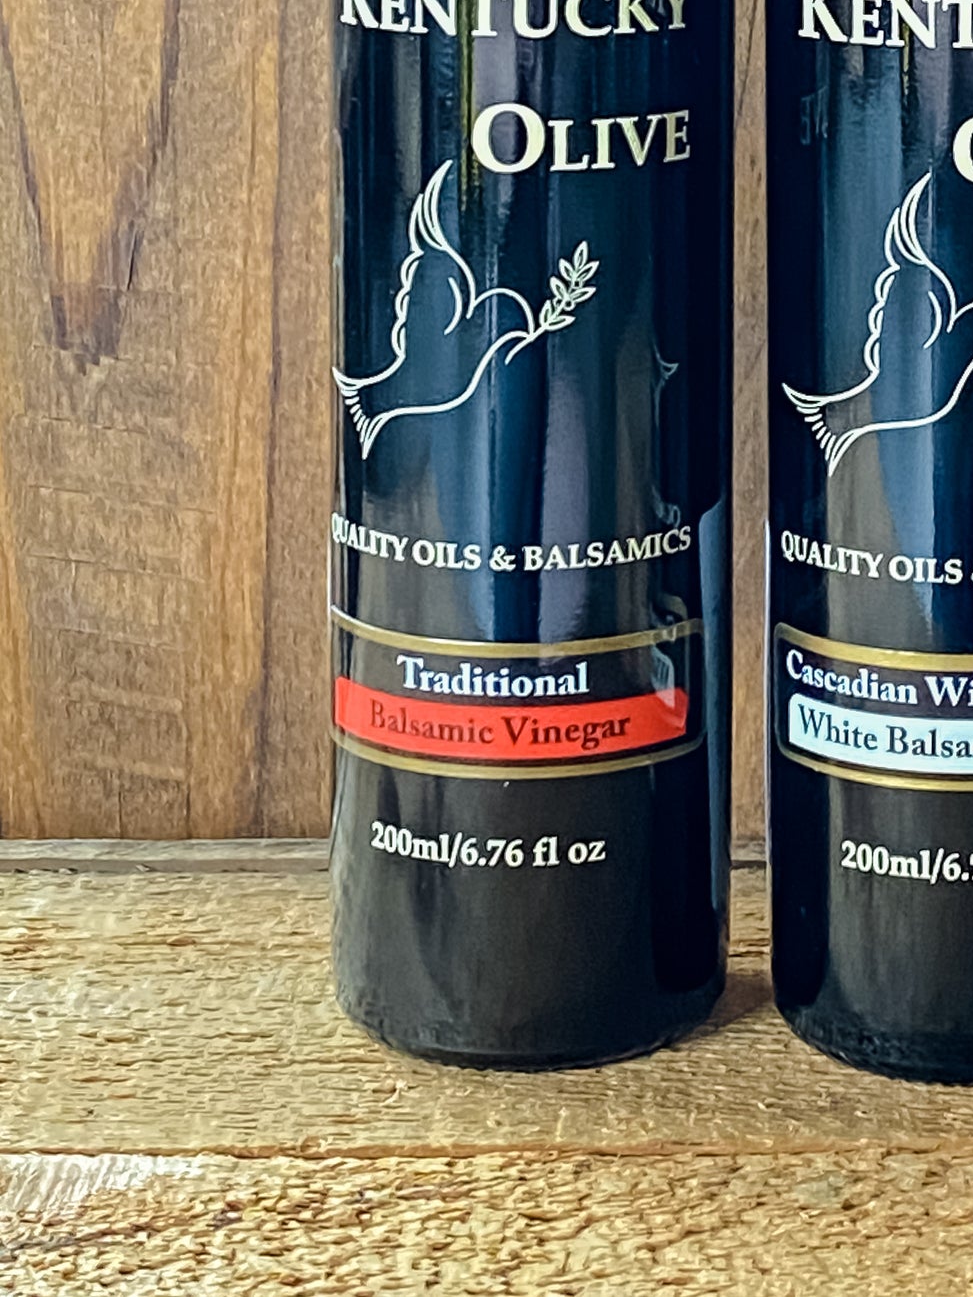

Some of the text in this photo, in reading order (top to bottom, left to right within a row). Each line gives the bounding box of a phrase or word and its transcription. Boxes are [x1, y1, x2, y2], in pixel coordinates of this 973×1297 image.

[471, 102, 691, 173] OLIVE
[412, 539, 481, 570] OILS
[489, 546, 517, 572] &
[524, 526, 691, 571] BALSAMICS
[781, 529, 884, 578] QUALITY
[888, 555, 963, 584] OILS
[396, 655, 590, 697] Traditional
[785, 649, 918, 704] Cascadian
[370, 699, 631, 750] Balsamic Vinegar
[797, 704, 878, 750] White
[371, 821, 606, 868] 200ml/6.76 fl oz
